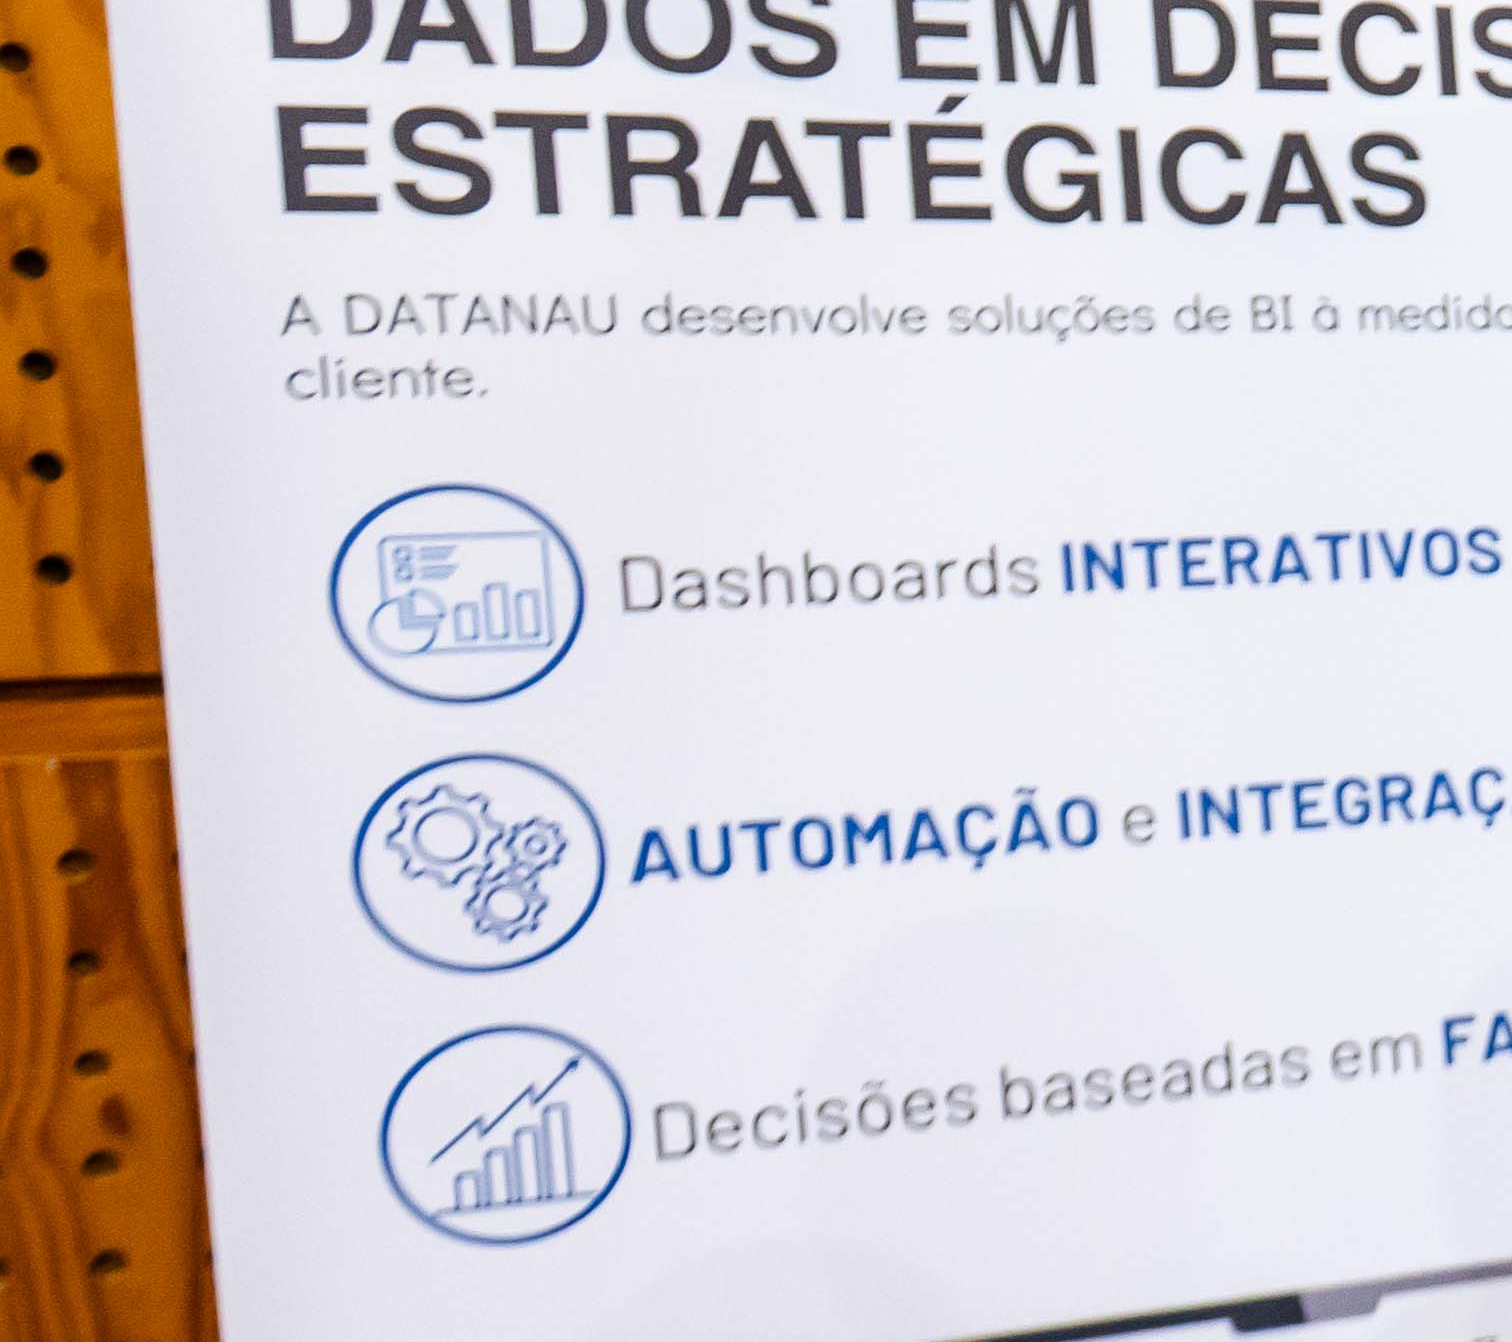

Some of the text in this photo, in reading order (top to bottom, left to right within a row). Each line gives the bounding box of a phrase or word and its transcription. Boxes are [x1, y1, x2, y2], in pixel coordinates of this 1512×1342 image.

[275, 94, 1428, 227] ESTRATÉGICAS
[281, 292, 321, 337] A
[344, 292, 618, 337] DATANAU
[641, 292, 929, 338] desenvolve
[947, 293, 1154, 345] soluções
[1174, 294, 1231, 334] de
[1251, 294, 1295, 335] BI
[1314, 295, 1341, 334] à
[284, 353, 490, 401] cliente.
[620, 526, 1503, 616] Dashboards INTERATIVOS
[629, 785, 1101, 887] AUTOMAÇÃO
[1122, 801, 1158, 846] e
[651, 1075, 979, 1162] Decisões
[998, 1039, 1311, 1120] baseadas
[1329, 1029, 1424, 1082] em
